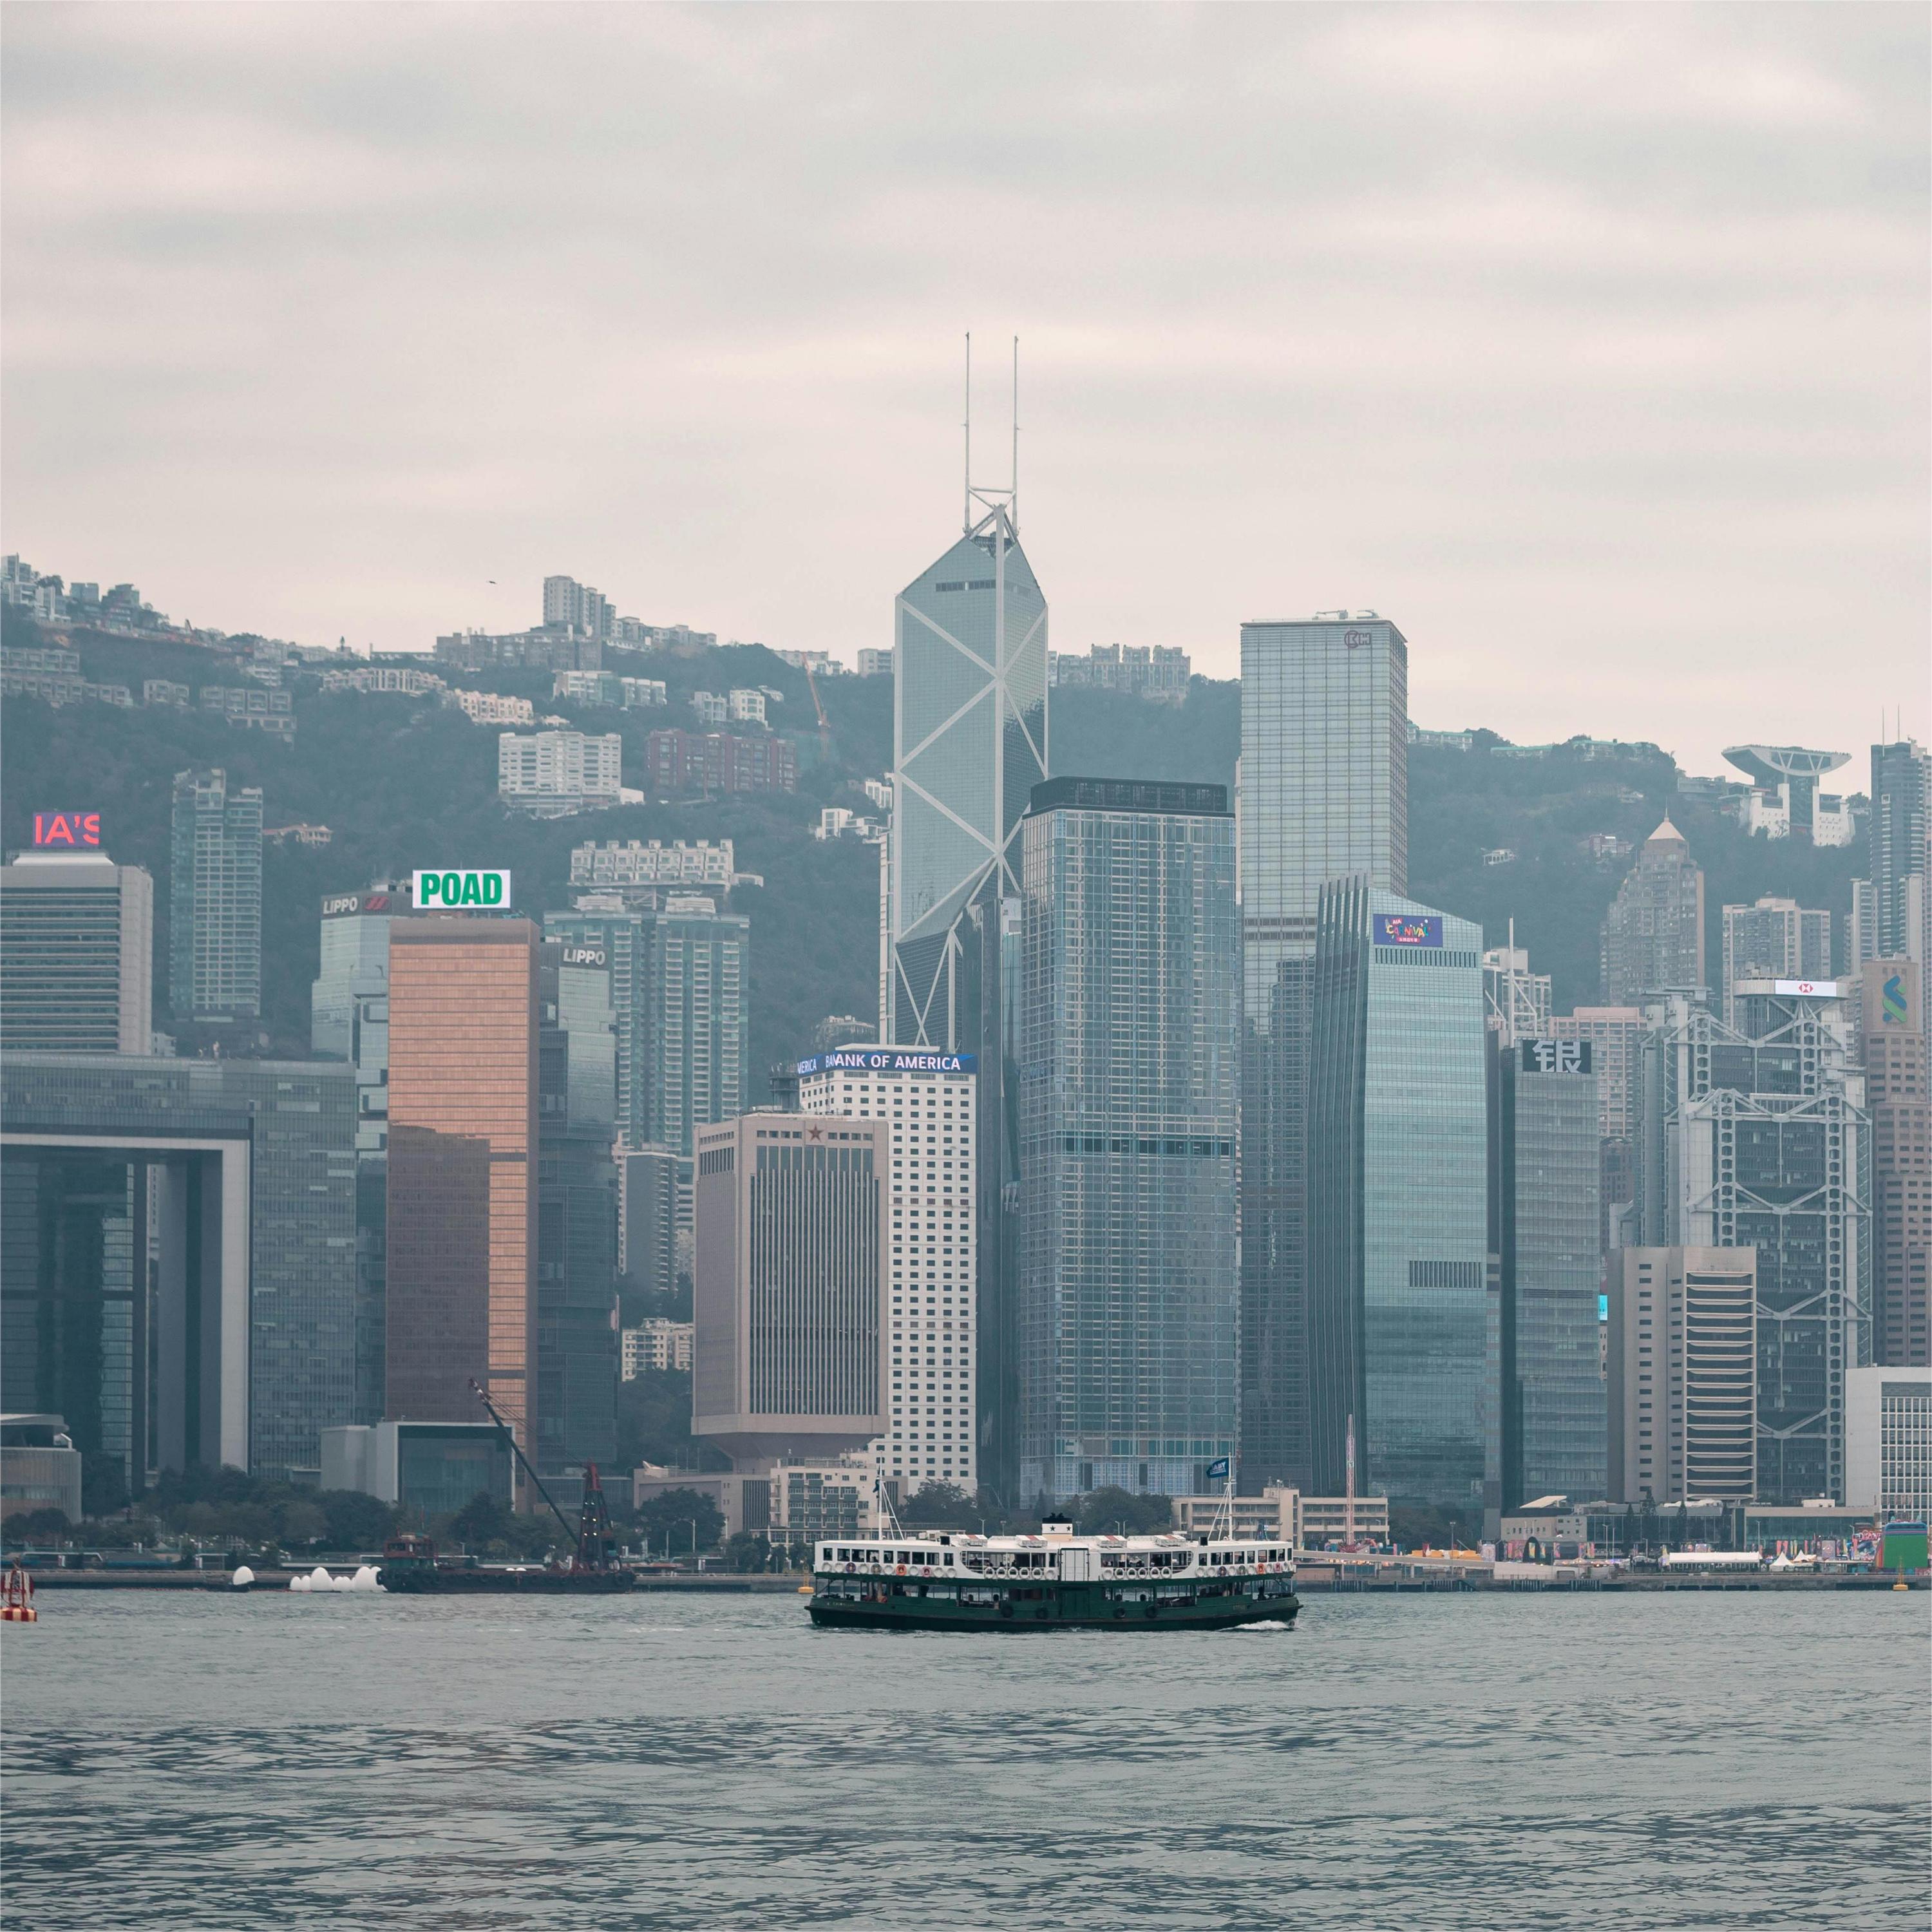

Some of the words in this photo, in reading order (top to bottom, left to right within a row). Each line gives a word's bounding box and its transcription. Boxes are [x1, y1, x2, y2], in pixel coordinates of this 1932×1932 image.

[421, 873, 502, 906] POAD
[323, 897, 358, 914] LIPPO
[1386, 924, 1429, 938] CARNIVAL
[563, 948, 605, 965] LIPPO
[871, 1054, 891, 1068] OF
[895, 1056, 961, 1070] AMERICA
